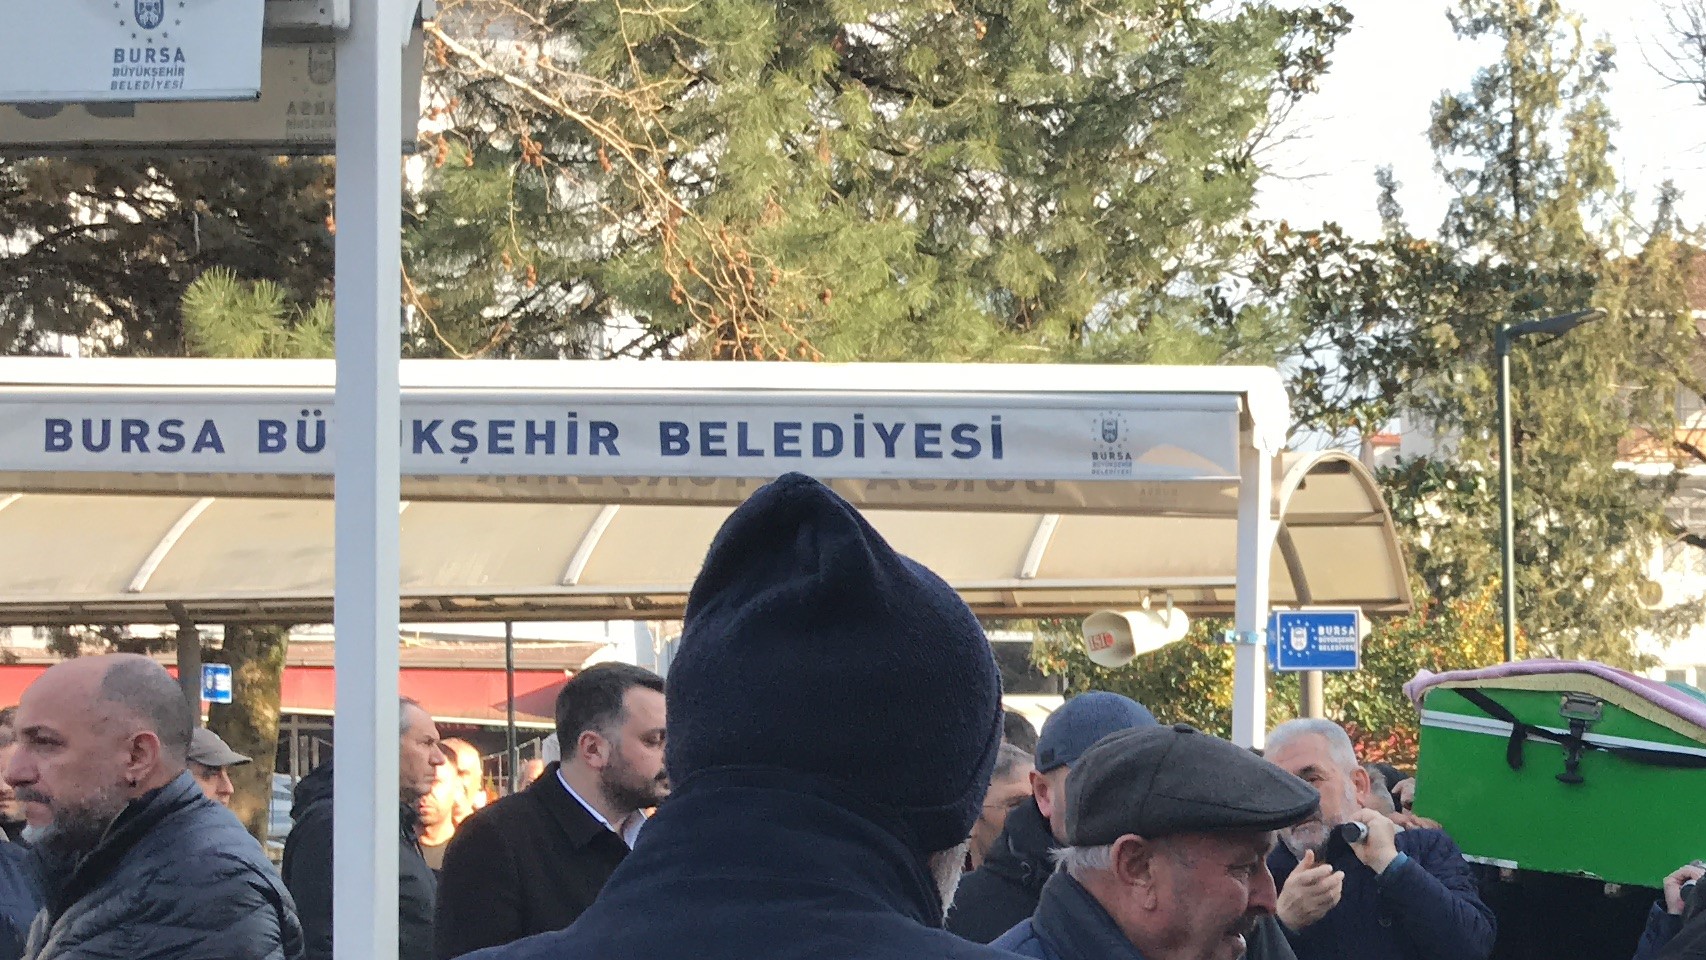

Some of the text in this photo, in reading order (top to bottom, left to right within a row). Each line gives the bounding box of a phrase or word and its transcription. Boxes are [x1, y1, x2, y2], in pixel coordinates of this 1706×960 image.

[113, 47, 186, 63] BURSA
[112, 64, 185, 78] BÜYÜKŞEHİR
[110, 78, 184, 90] BELEDİYESİ
[44, 409, 1004, 464] BURSA BÜKŞEHİR BELEDİYESİ
[1092, 451, 1132, 460] BURSA
[1318, 625, 1355, 635] BURSA
